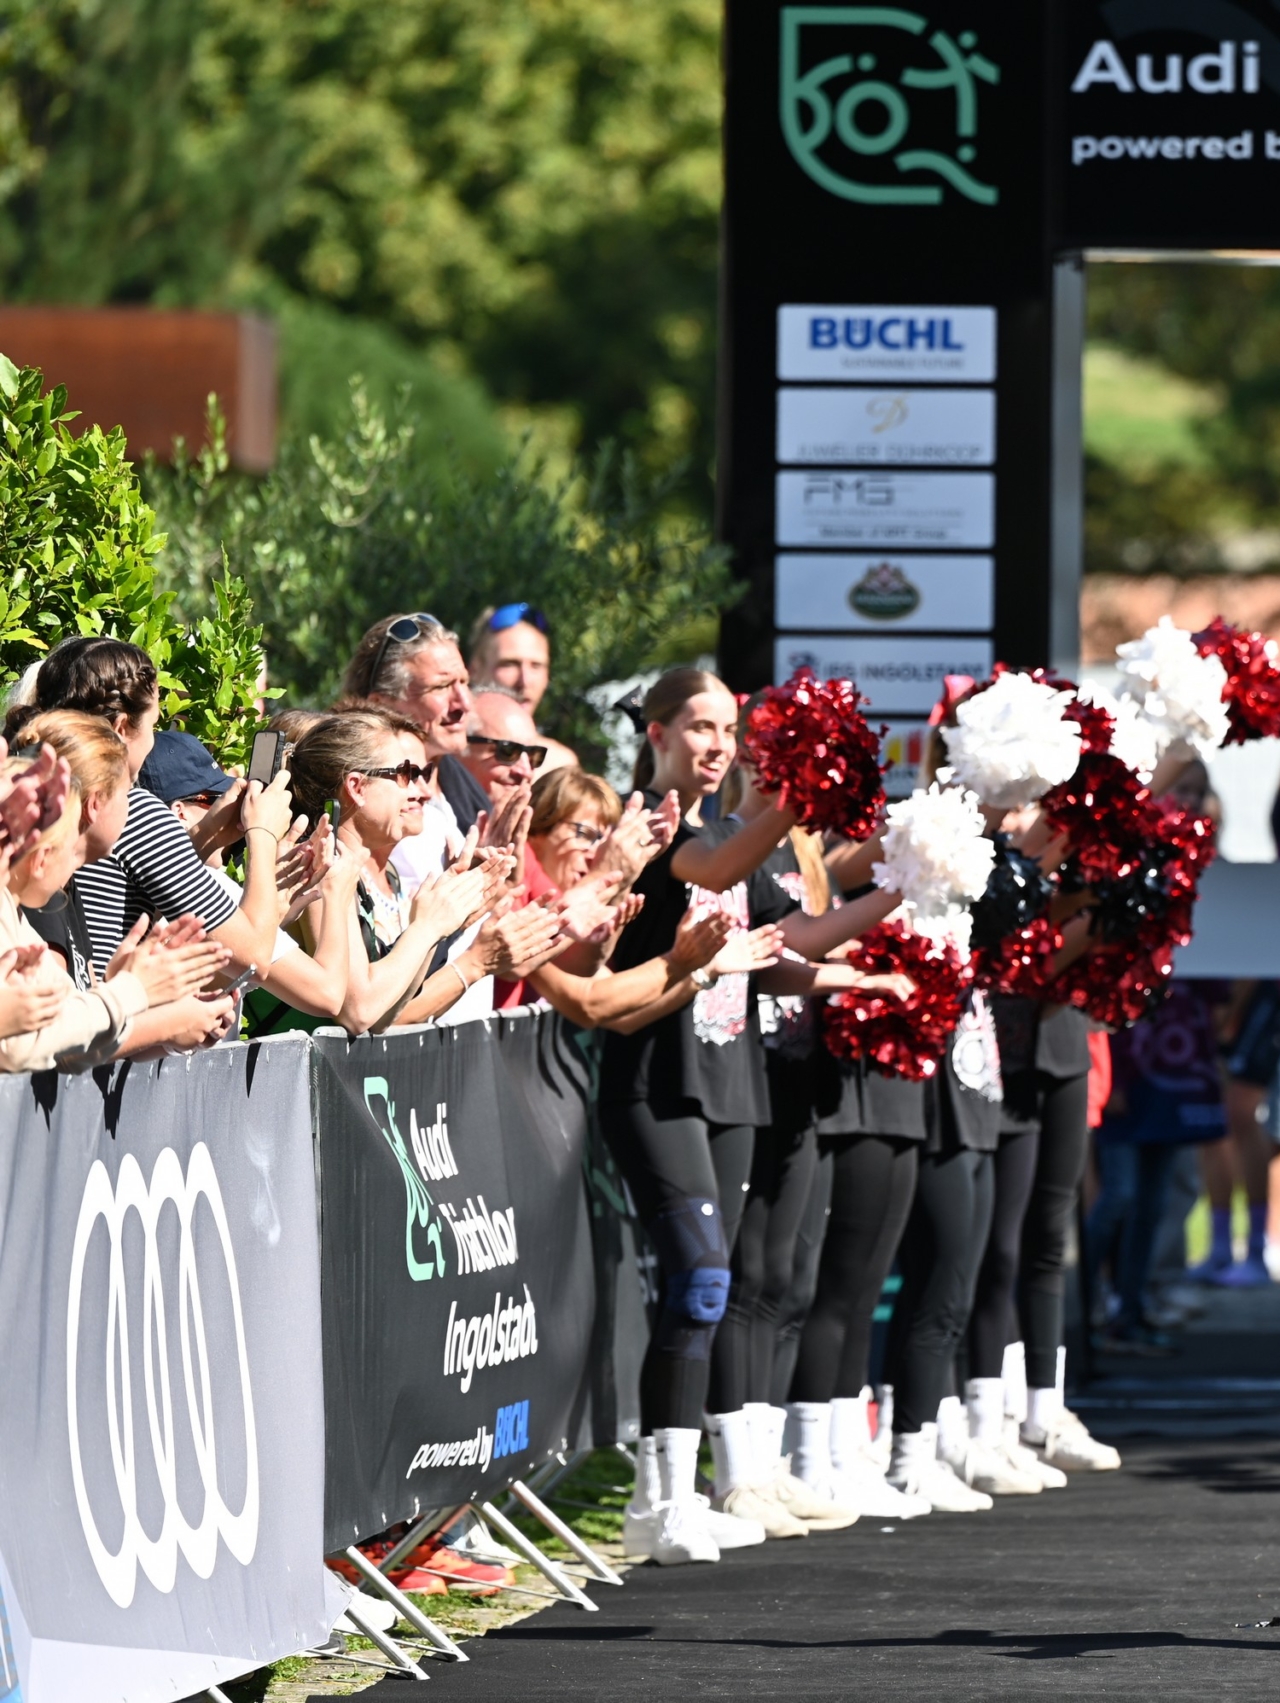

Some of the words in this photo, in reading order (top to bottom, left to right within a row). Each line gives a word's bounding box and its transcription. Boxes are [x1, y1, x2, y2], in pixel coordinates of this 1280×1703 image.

[1072, 40, 1260, 94] Audi
[1073, 131, 1253, 164] powered
[809, 317, 964, 351] BÜCHL
[409, 1102, 459, 1182] Audi
[443, 1282, 538, 1394] Ingolstadt
[405, 1426, 482, 1480] powered
[478, 1425, 494, 1474] by
